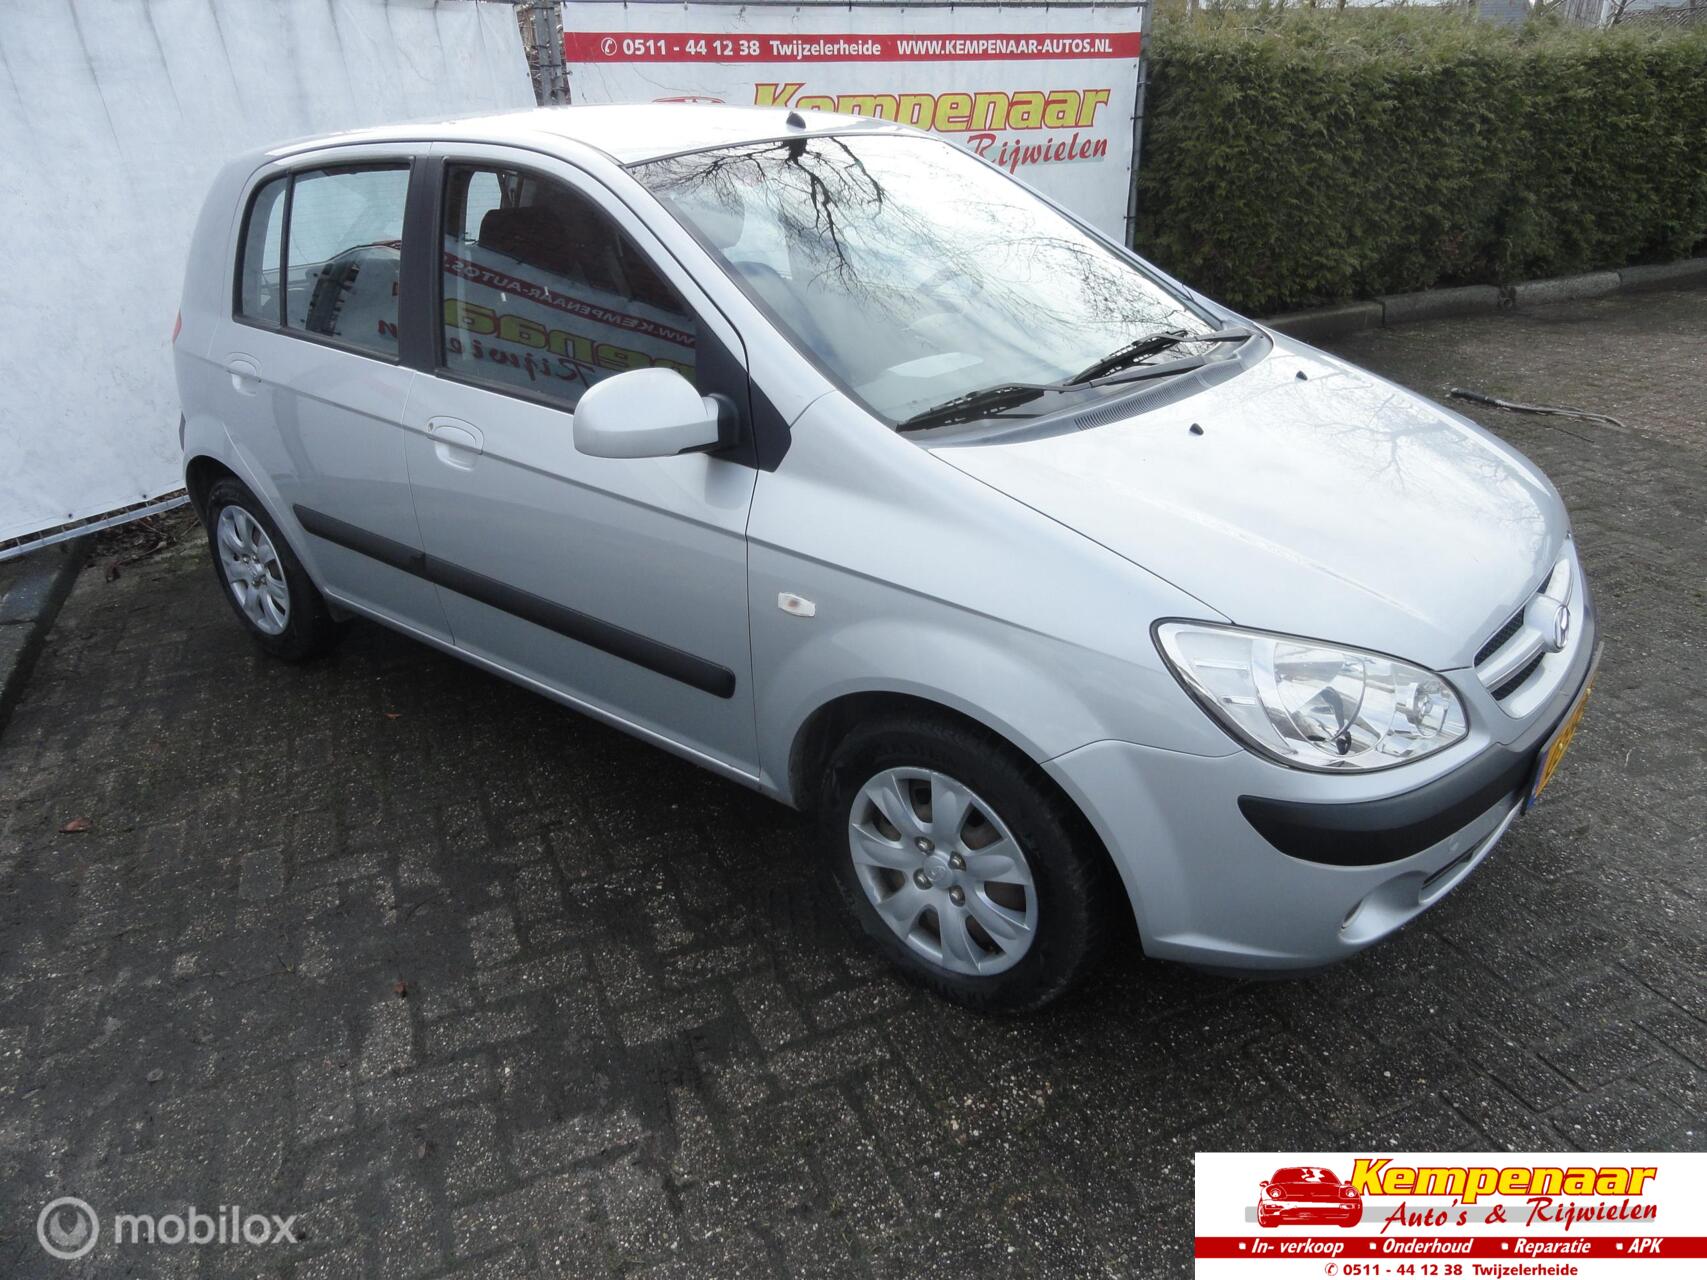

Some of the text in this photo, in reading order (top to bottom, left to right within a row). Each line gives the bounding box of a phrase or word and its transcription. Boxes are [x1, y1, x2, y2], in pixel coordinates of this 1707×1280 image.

[622, 39, 667, 55] 0511
[685, 40, 707, 55] 44
[713, 40, 733, 55] 12
[739, 40, 760, 55] 38
[769, 40, 881, 59] Twijzelerheide
[897, 39, 1113, 54] WWW.KEMPENAAR-AUTOS.NL
[967, 132, 1108, 174] Rijwielen
